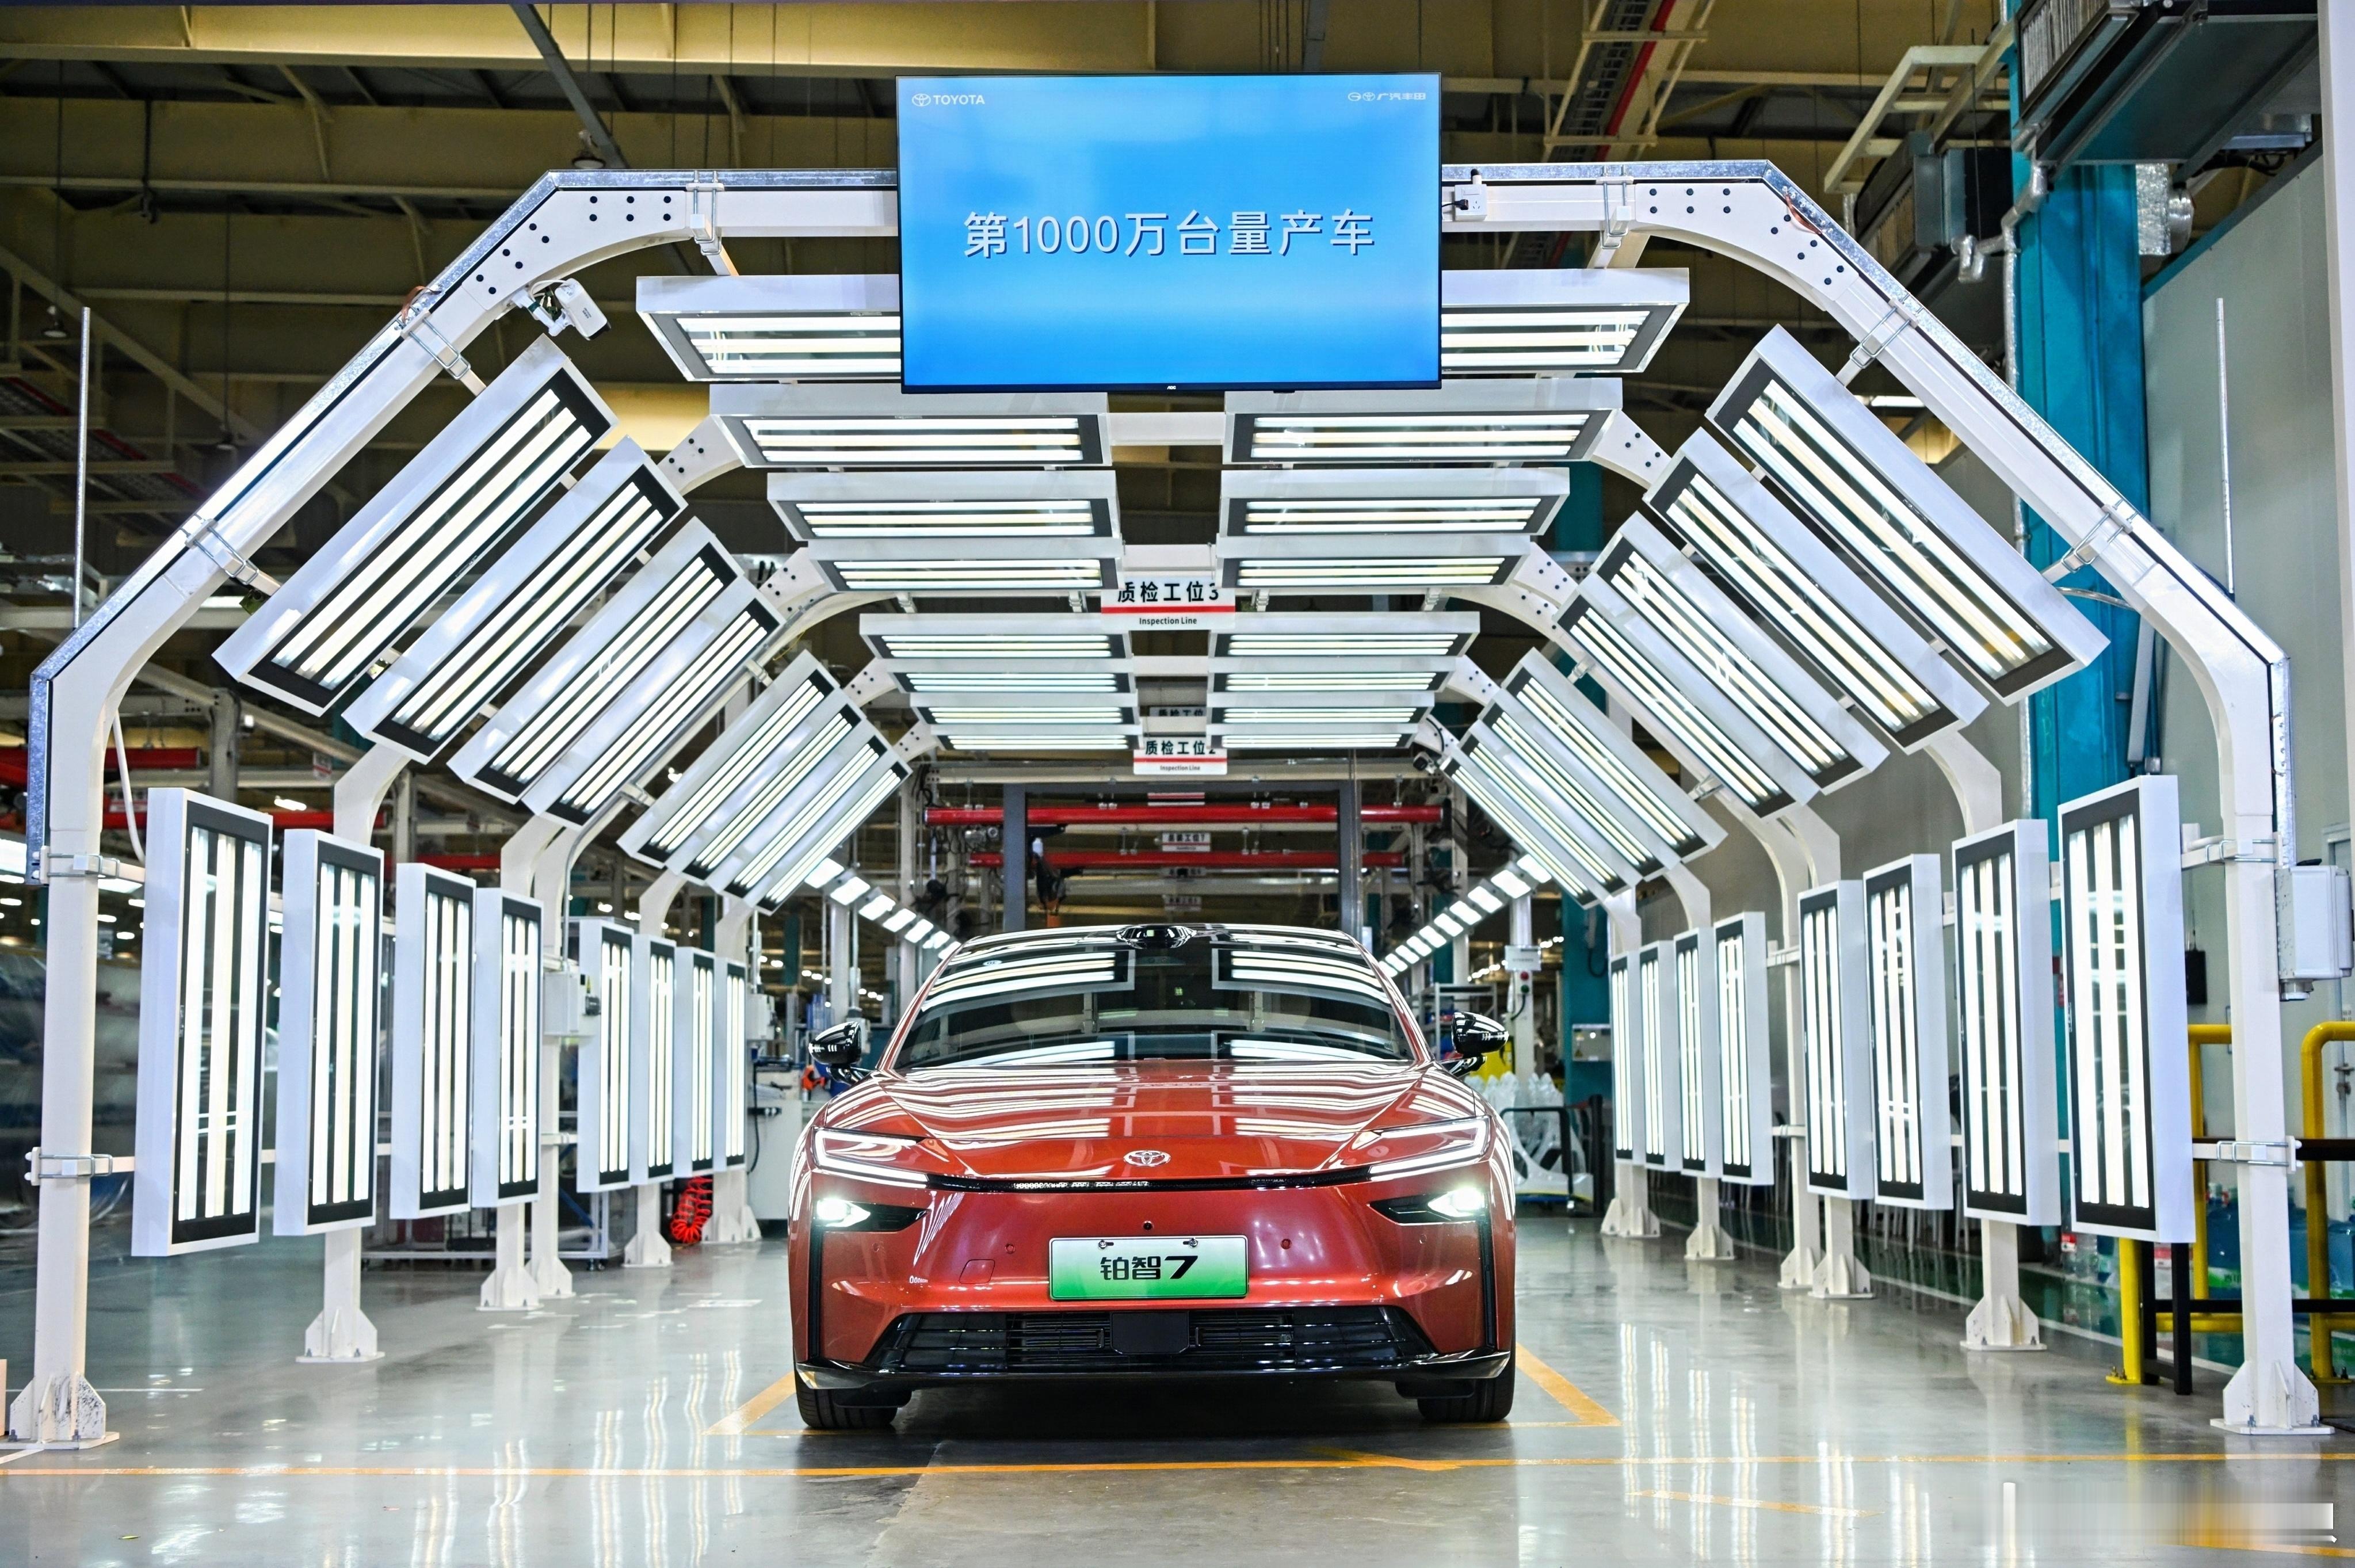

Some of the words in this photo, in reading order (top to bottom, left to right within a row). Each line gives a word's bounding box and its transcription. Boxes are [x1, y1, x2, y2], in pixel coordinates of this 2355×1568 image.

[933, 94, 986, 105] TOYOTA
[1376, 93, 1426, 101] 广汽丰田
[963, 209, 1373, 258] 第1000万台量产车
[1117, 581, 1219, 602] 质检工位3
[1139, 617, 1180, 626] Inspection
[1181, 617, 1197, 625] Line
[1100, 1255, 1199, 1280] 铂智7
